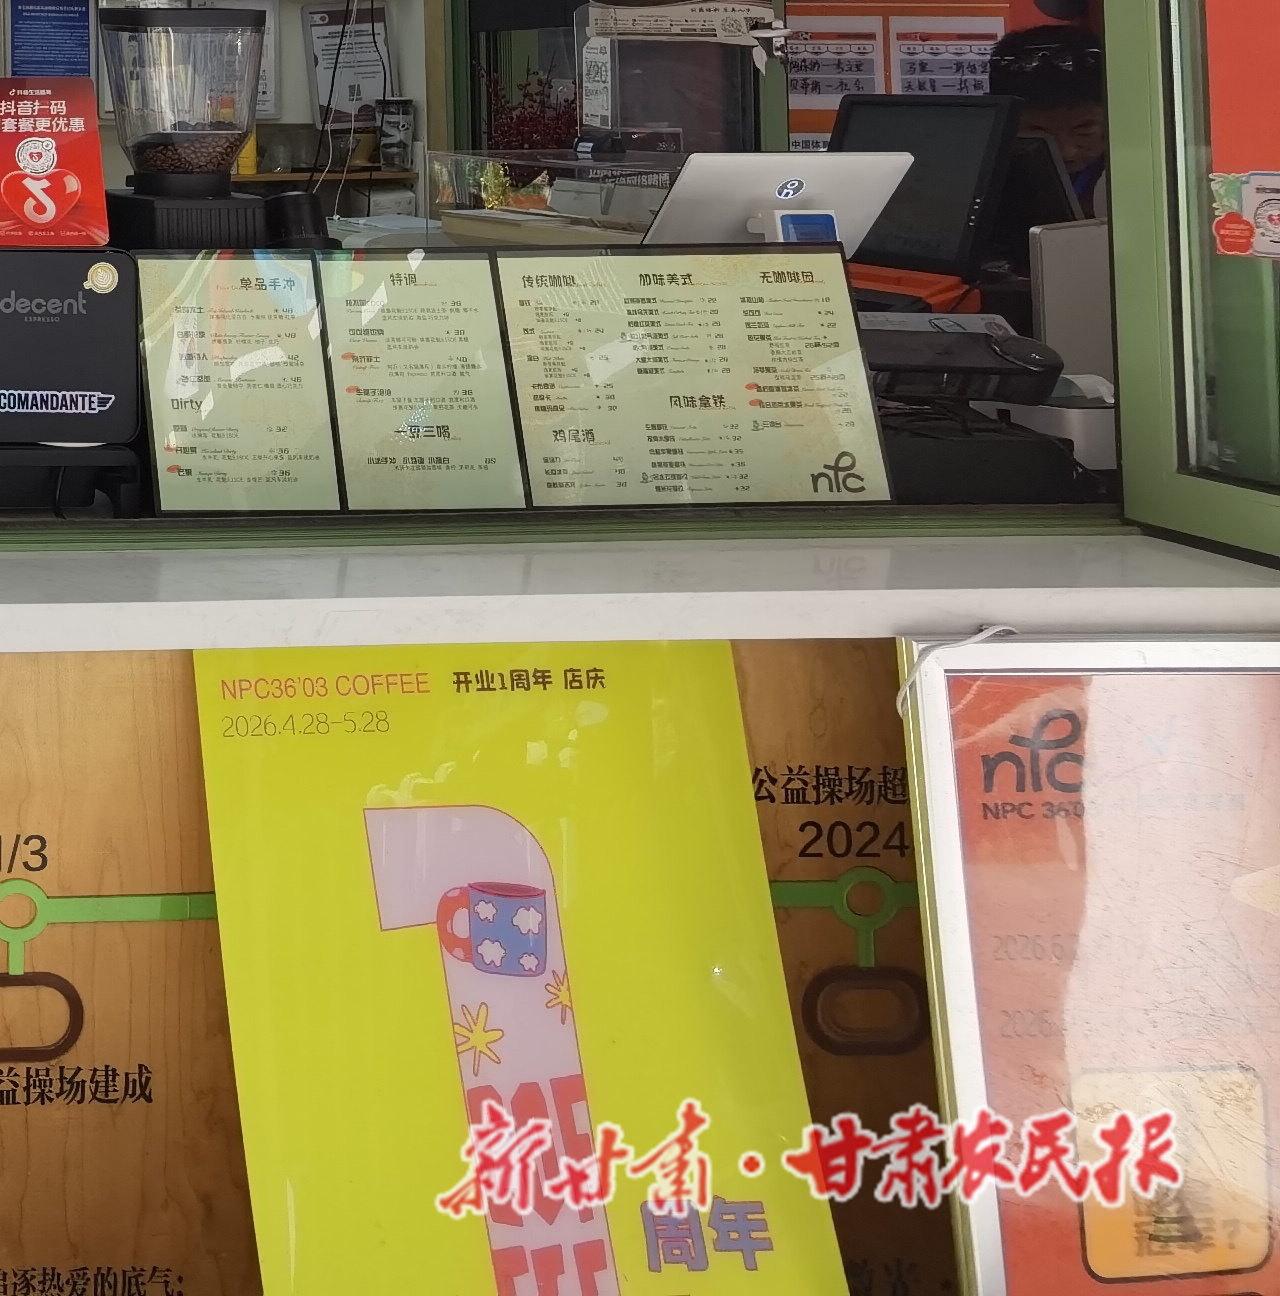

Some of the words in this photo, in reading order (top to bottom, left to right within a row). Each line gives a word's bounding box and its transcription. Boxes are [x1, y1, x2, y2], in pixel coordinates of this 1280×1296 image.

[0, 100, 67, 116] 抖音扫码
[390, 273, 417, 286] 特调
[522, 275, 576, 288] 传统咖啡
[639, 273, 693, 286] 加味美式
[760, 271, 815, 284] 无咖啡因
[171, 398, 203, 412] Dirty
[669, 394, 726, 408] 风味拿铁
[552, 429, 595, 442] 鸡尾酒
[336, 671, 431, 696] COFFEE
[452, 668, 554, 694] 开业1周年
[564, 667, 606, 692] 店庆
[222, 711, 390, 739] 2026.4.28-5.28
[982, 802, 1035, 820] NPC
[798, 821, 909, 858] 2024
[640, 1195, 774, 1273] 周年
